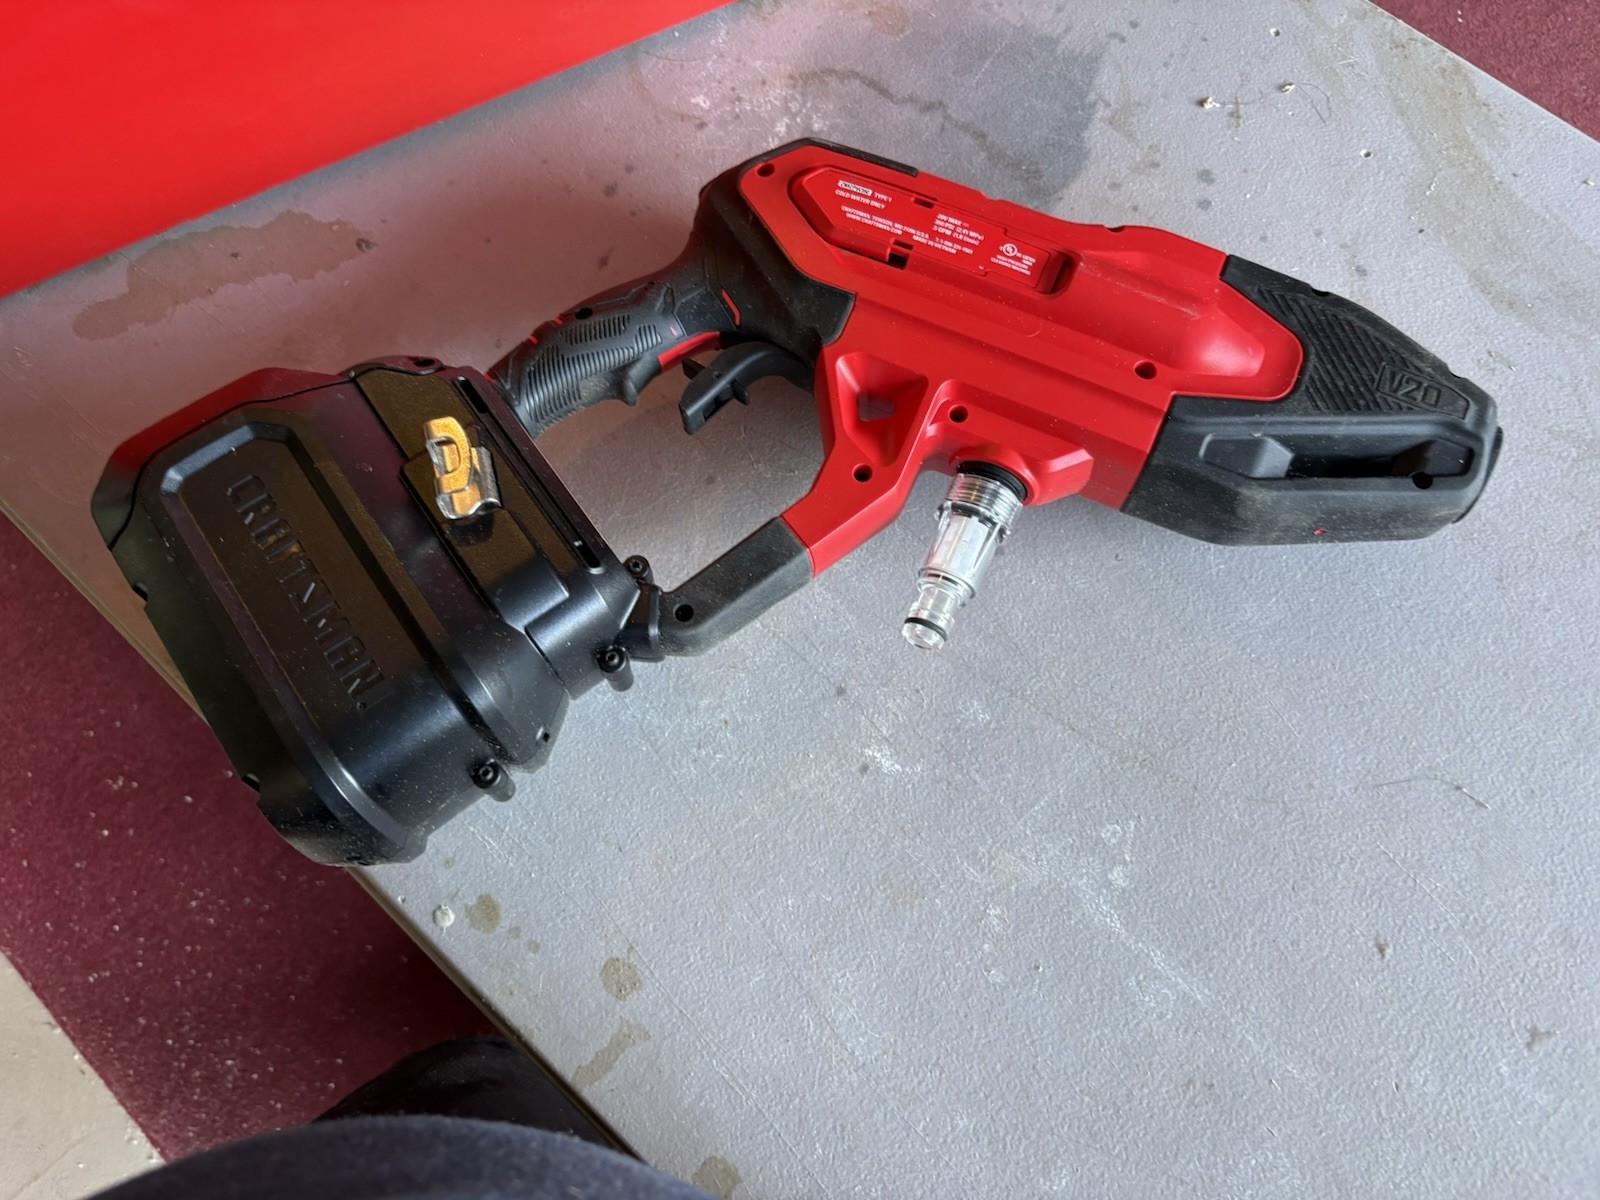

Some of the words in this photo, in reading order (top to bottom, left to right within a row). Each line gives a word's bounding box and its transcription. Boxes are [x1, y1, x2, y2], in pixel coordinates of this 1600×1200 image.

[835, 189, 850, 198] COLD
[850, 194, 870, 205] WATER
[870, 200, 886, 209] ONLY
[948, 217, 962, 226] MAX
[225, 474, 386, 700] CRAFTSMAN
